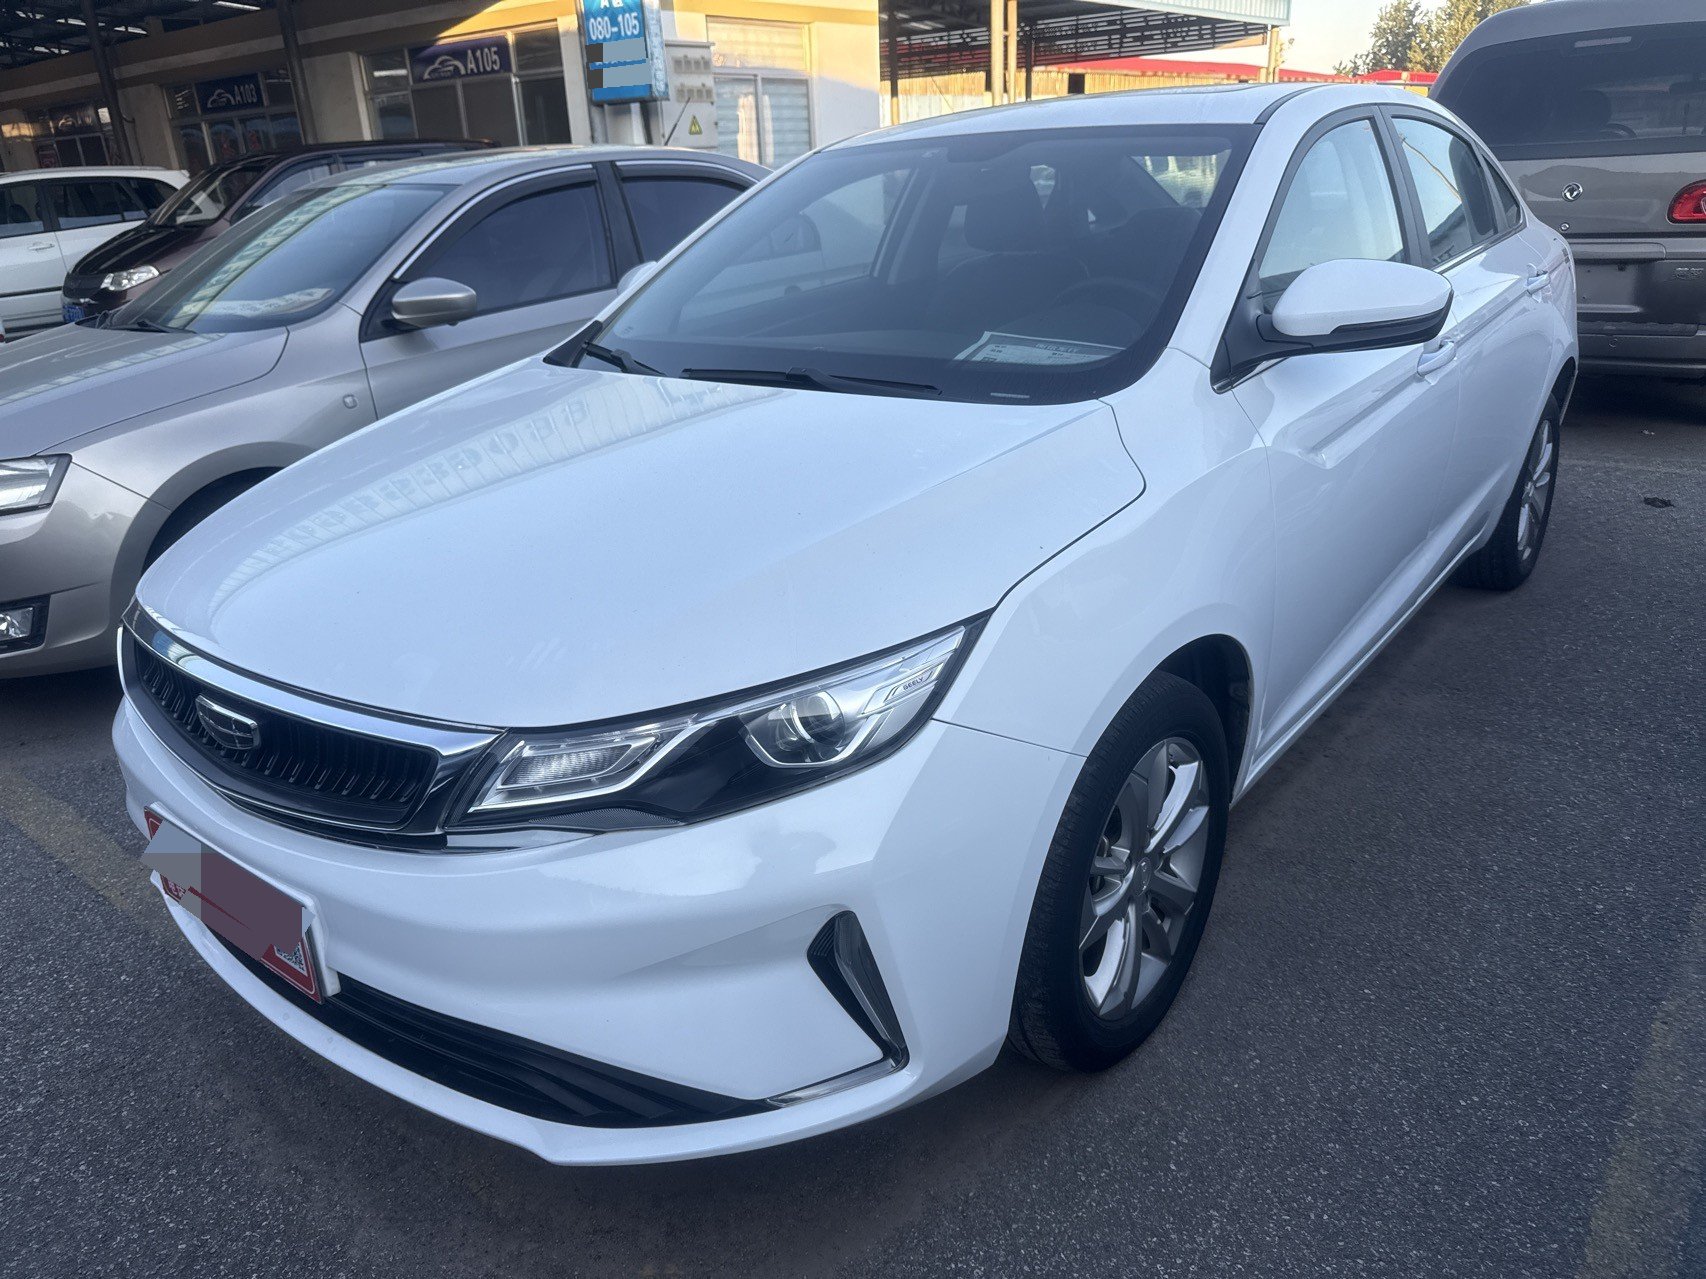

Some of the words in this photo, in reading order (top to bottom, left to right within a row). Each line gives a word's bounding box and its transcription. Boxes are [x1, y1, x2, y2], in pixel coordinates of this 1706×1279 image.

[588, 11, 640, 41] 080-105
[466, 46, 501, 74] A105
[233, 83, 258, 105] A103
